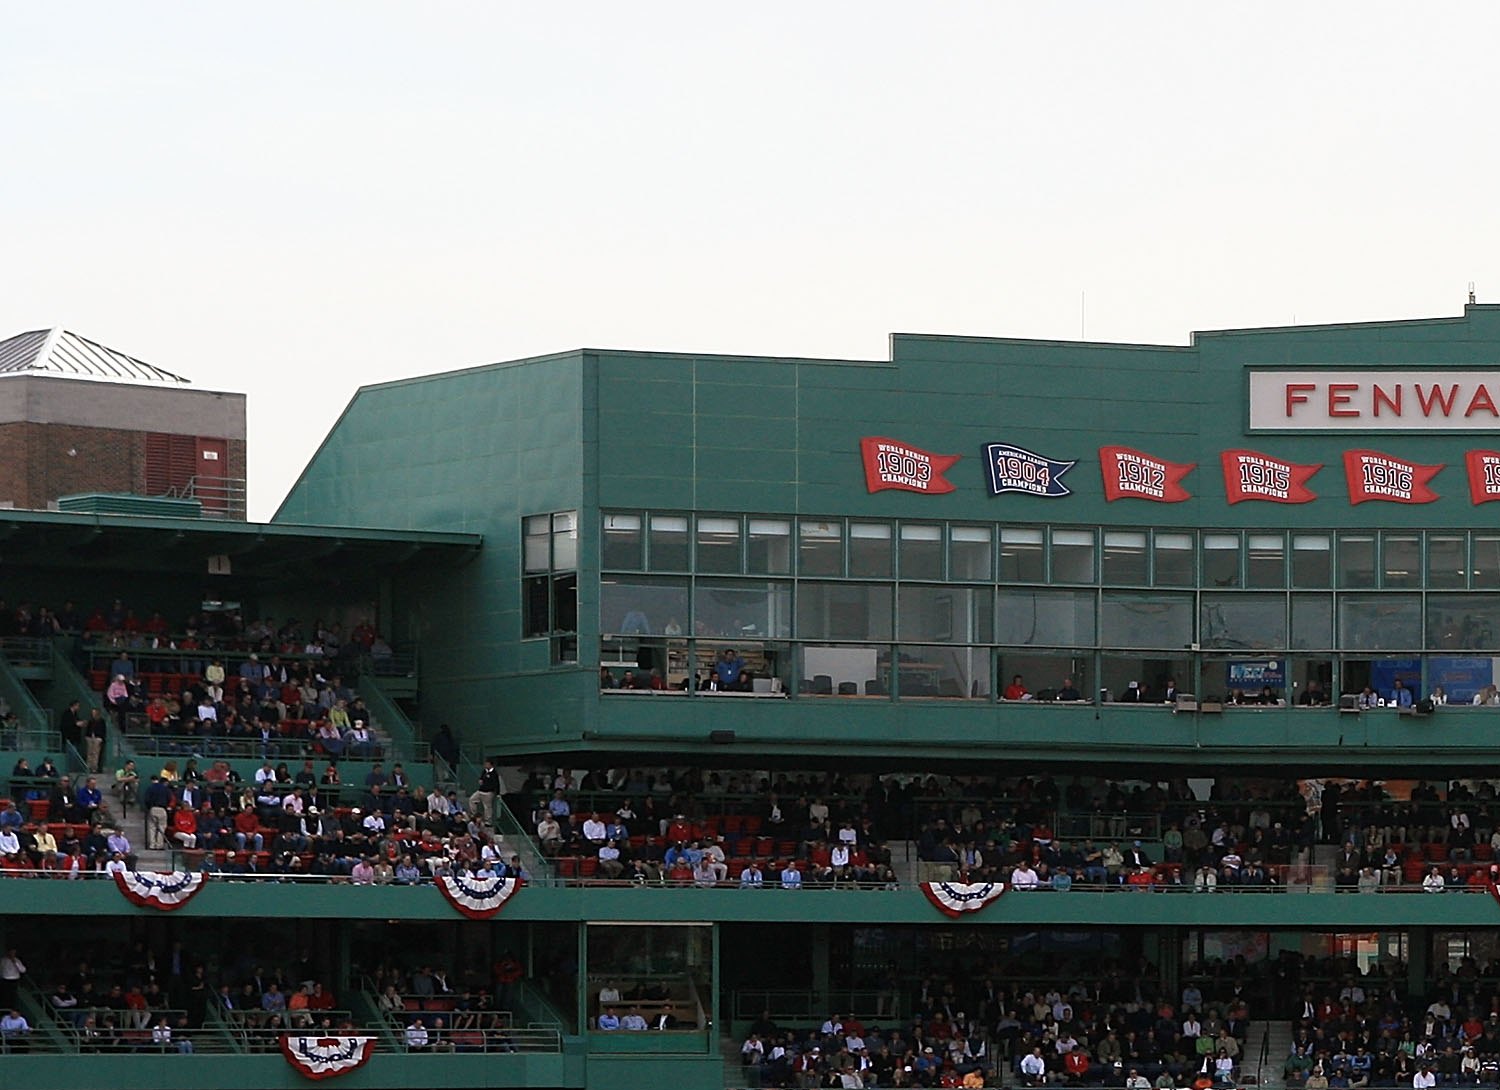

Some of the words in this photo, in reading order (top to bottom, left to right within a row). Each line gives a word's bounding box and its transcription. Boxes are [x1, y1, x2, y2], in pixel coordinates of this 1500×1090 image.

[878, 444, 904, 454] WORLD
[905, 450, 929, 463] SERIES
[998, 450, 1027, 460] AMERICAN
[1027, 456, 1048, 467] LEAGUE
[1116, 453, 1140, 464] WORLD
[1141, 458, 1165, 471] SERIES
[877, 452, 931, 481] 1903
[997, 456, 1050, 487] 1904
[1238, 456, 1264, 465] WORLD
[1265, 460, 1290, 472] SERIES
[1361, 456, 1387, 466] WORLD
[1388, 461, 1413, 473] SERIES
[881, 473, 927, 489] CHAMPIONS
[1118, 460, 1164, 490] 1912
[1240, 463, 1290, 490] 1915
[1362, 464, 1412, 491] 1916
[1002, 479, 1047, 494] CHAMPIONS
[1119, 482, 1164, 498] CHAMPIONS
[1241, 485, 1288, 499] CHAMPIONS
[1364, 485, 1411, 499] CHAMPIONS
